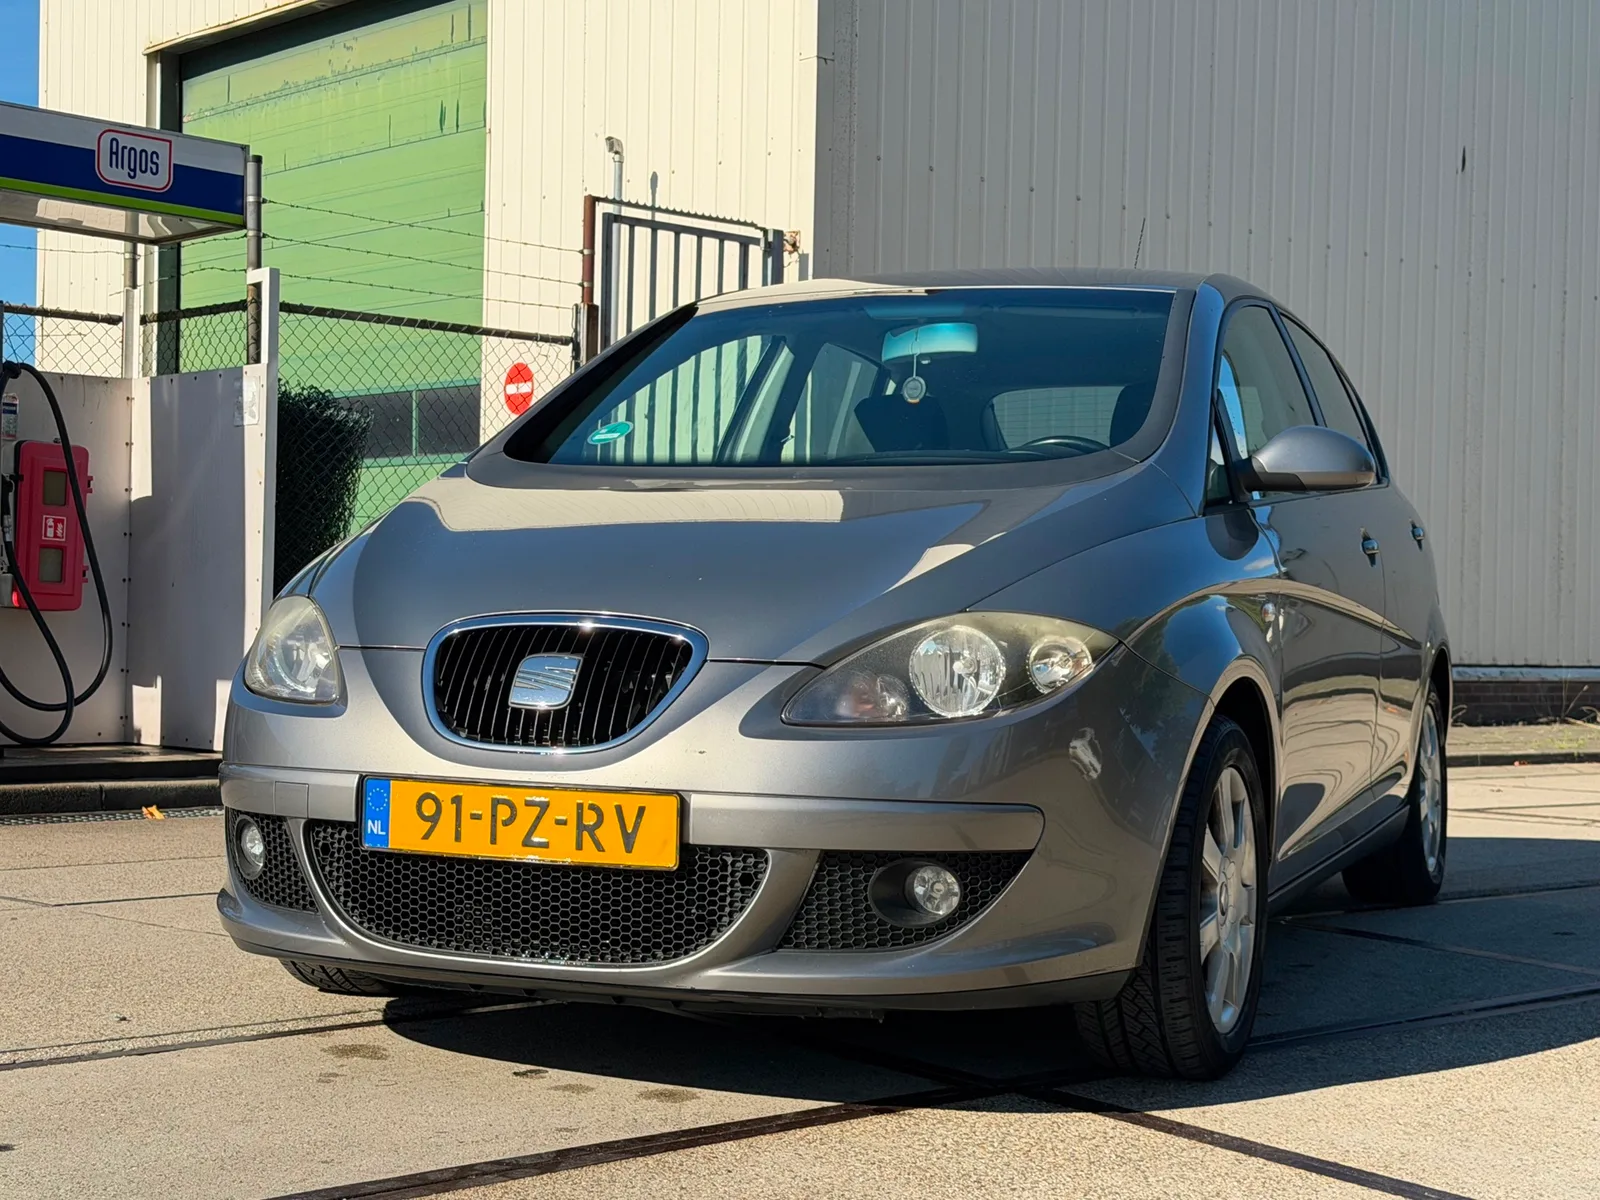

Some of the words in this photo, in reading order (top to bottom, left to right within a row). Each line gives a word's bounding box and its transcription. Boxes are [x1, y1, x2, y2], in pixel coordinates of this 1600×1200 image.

[109, 137, 160, 180] Argos
[367, 819, 387, 836] NL
[415, 791, 647, 854] 91-PZ-RV
